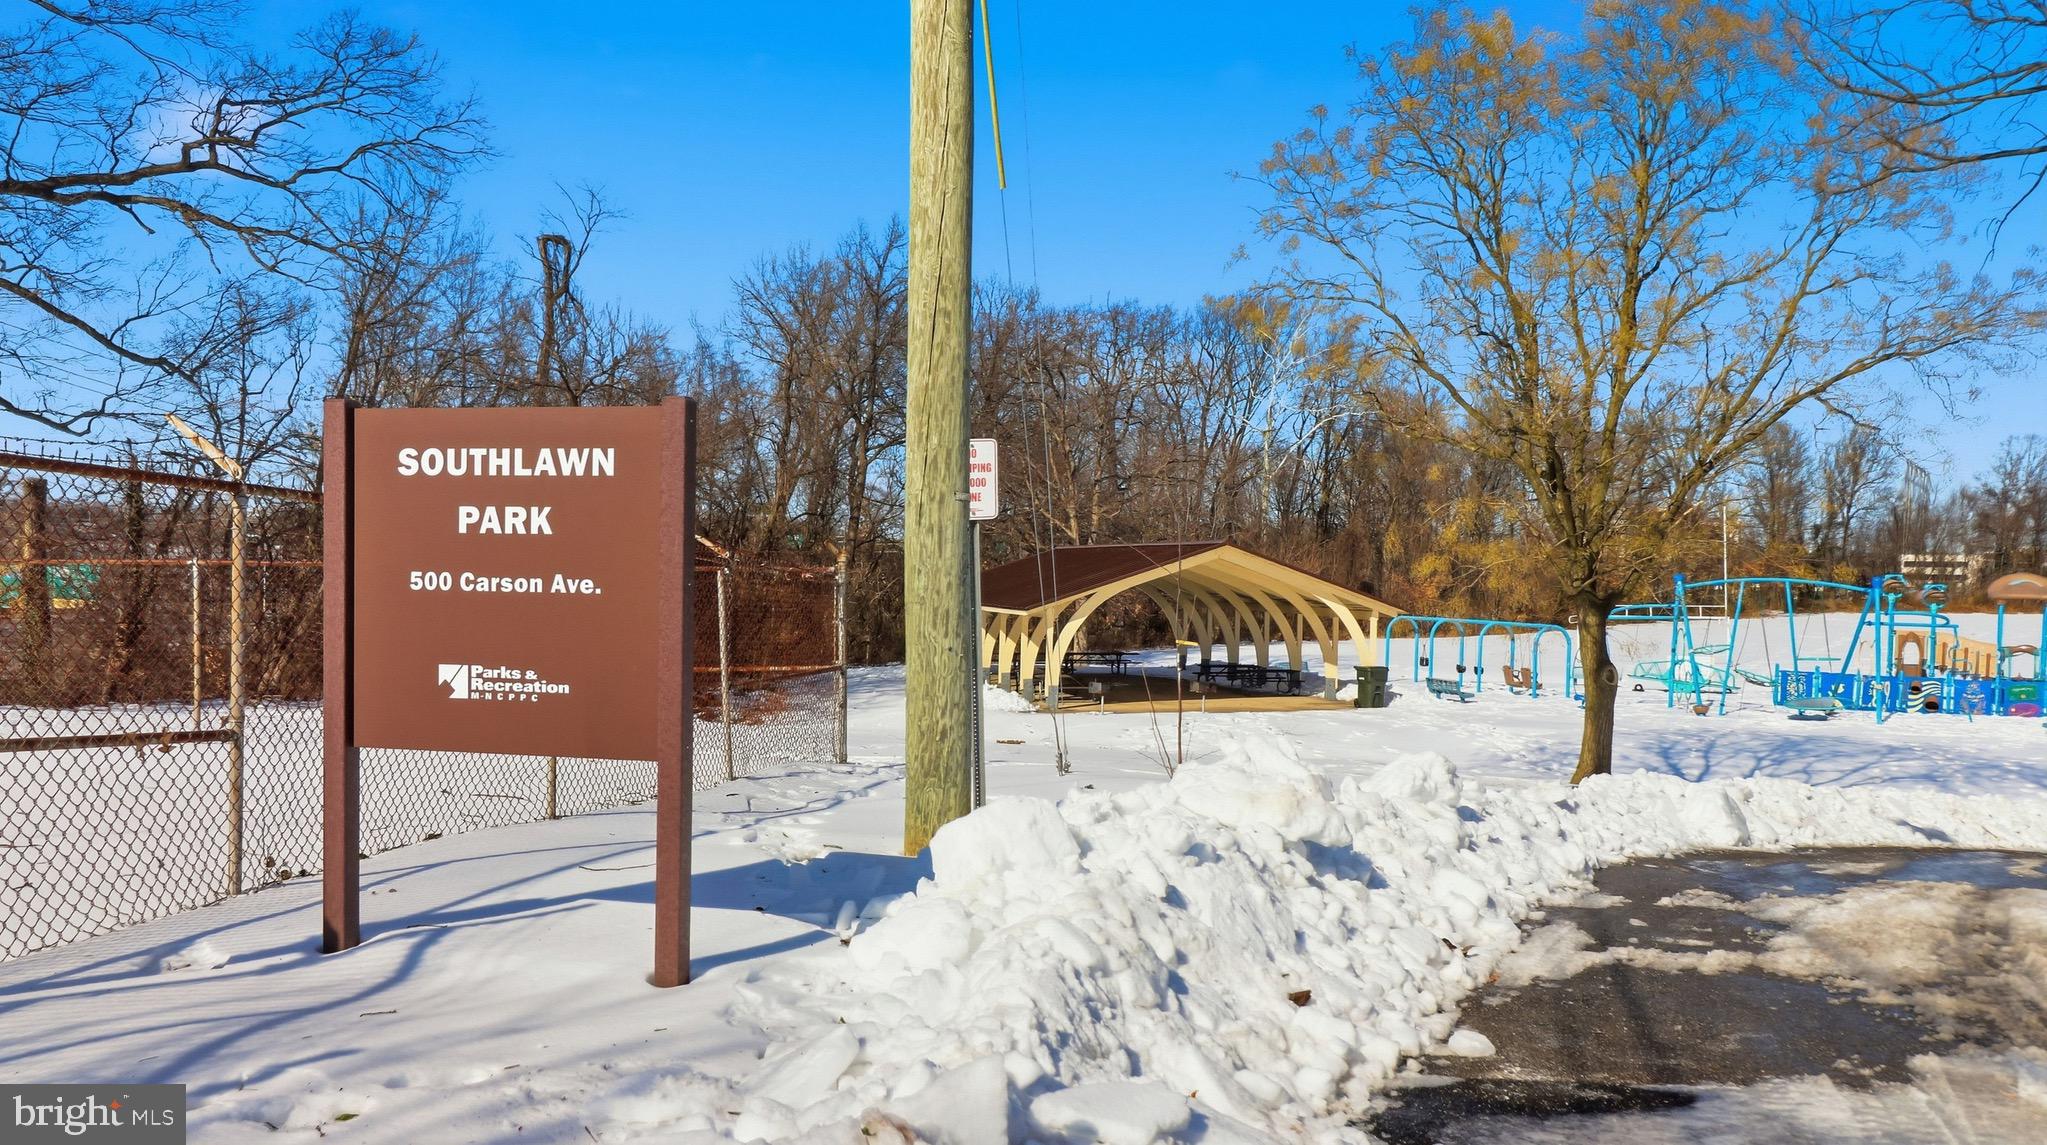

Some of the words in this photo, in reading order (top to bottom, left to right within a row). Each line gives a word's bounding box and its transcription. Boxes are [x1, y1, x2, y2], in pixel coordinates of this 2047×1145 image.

[397, 447, 615, 477] SOUTHLAWN
[969, 448, 977, 458] O
[458, 505, 553, 535] PARK
[409, 571, 453, 592] 500
[459, 571, 543, 593] Carson
[550, 573, 602, 595] Ave.
[470, 665, 522, 680] Parks
[524, 669, 538, 680] &
[470, 677, 570, 694] Recreation
